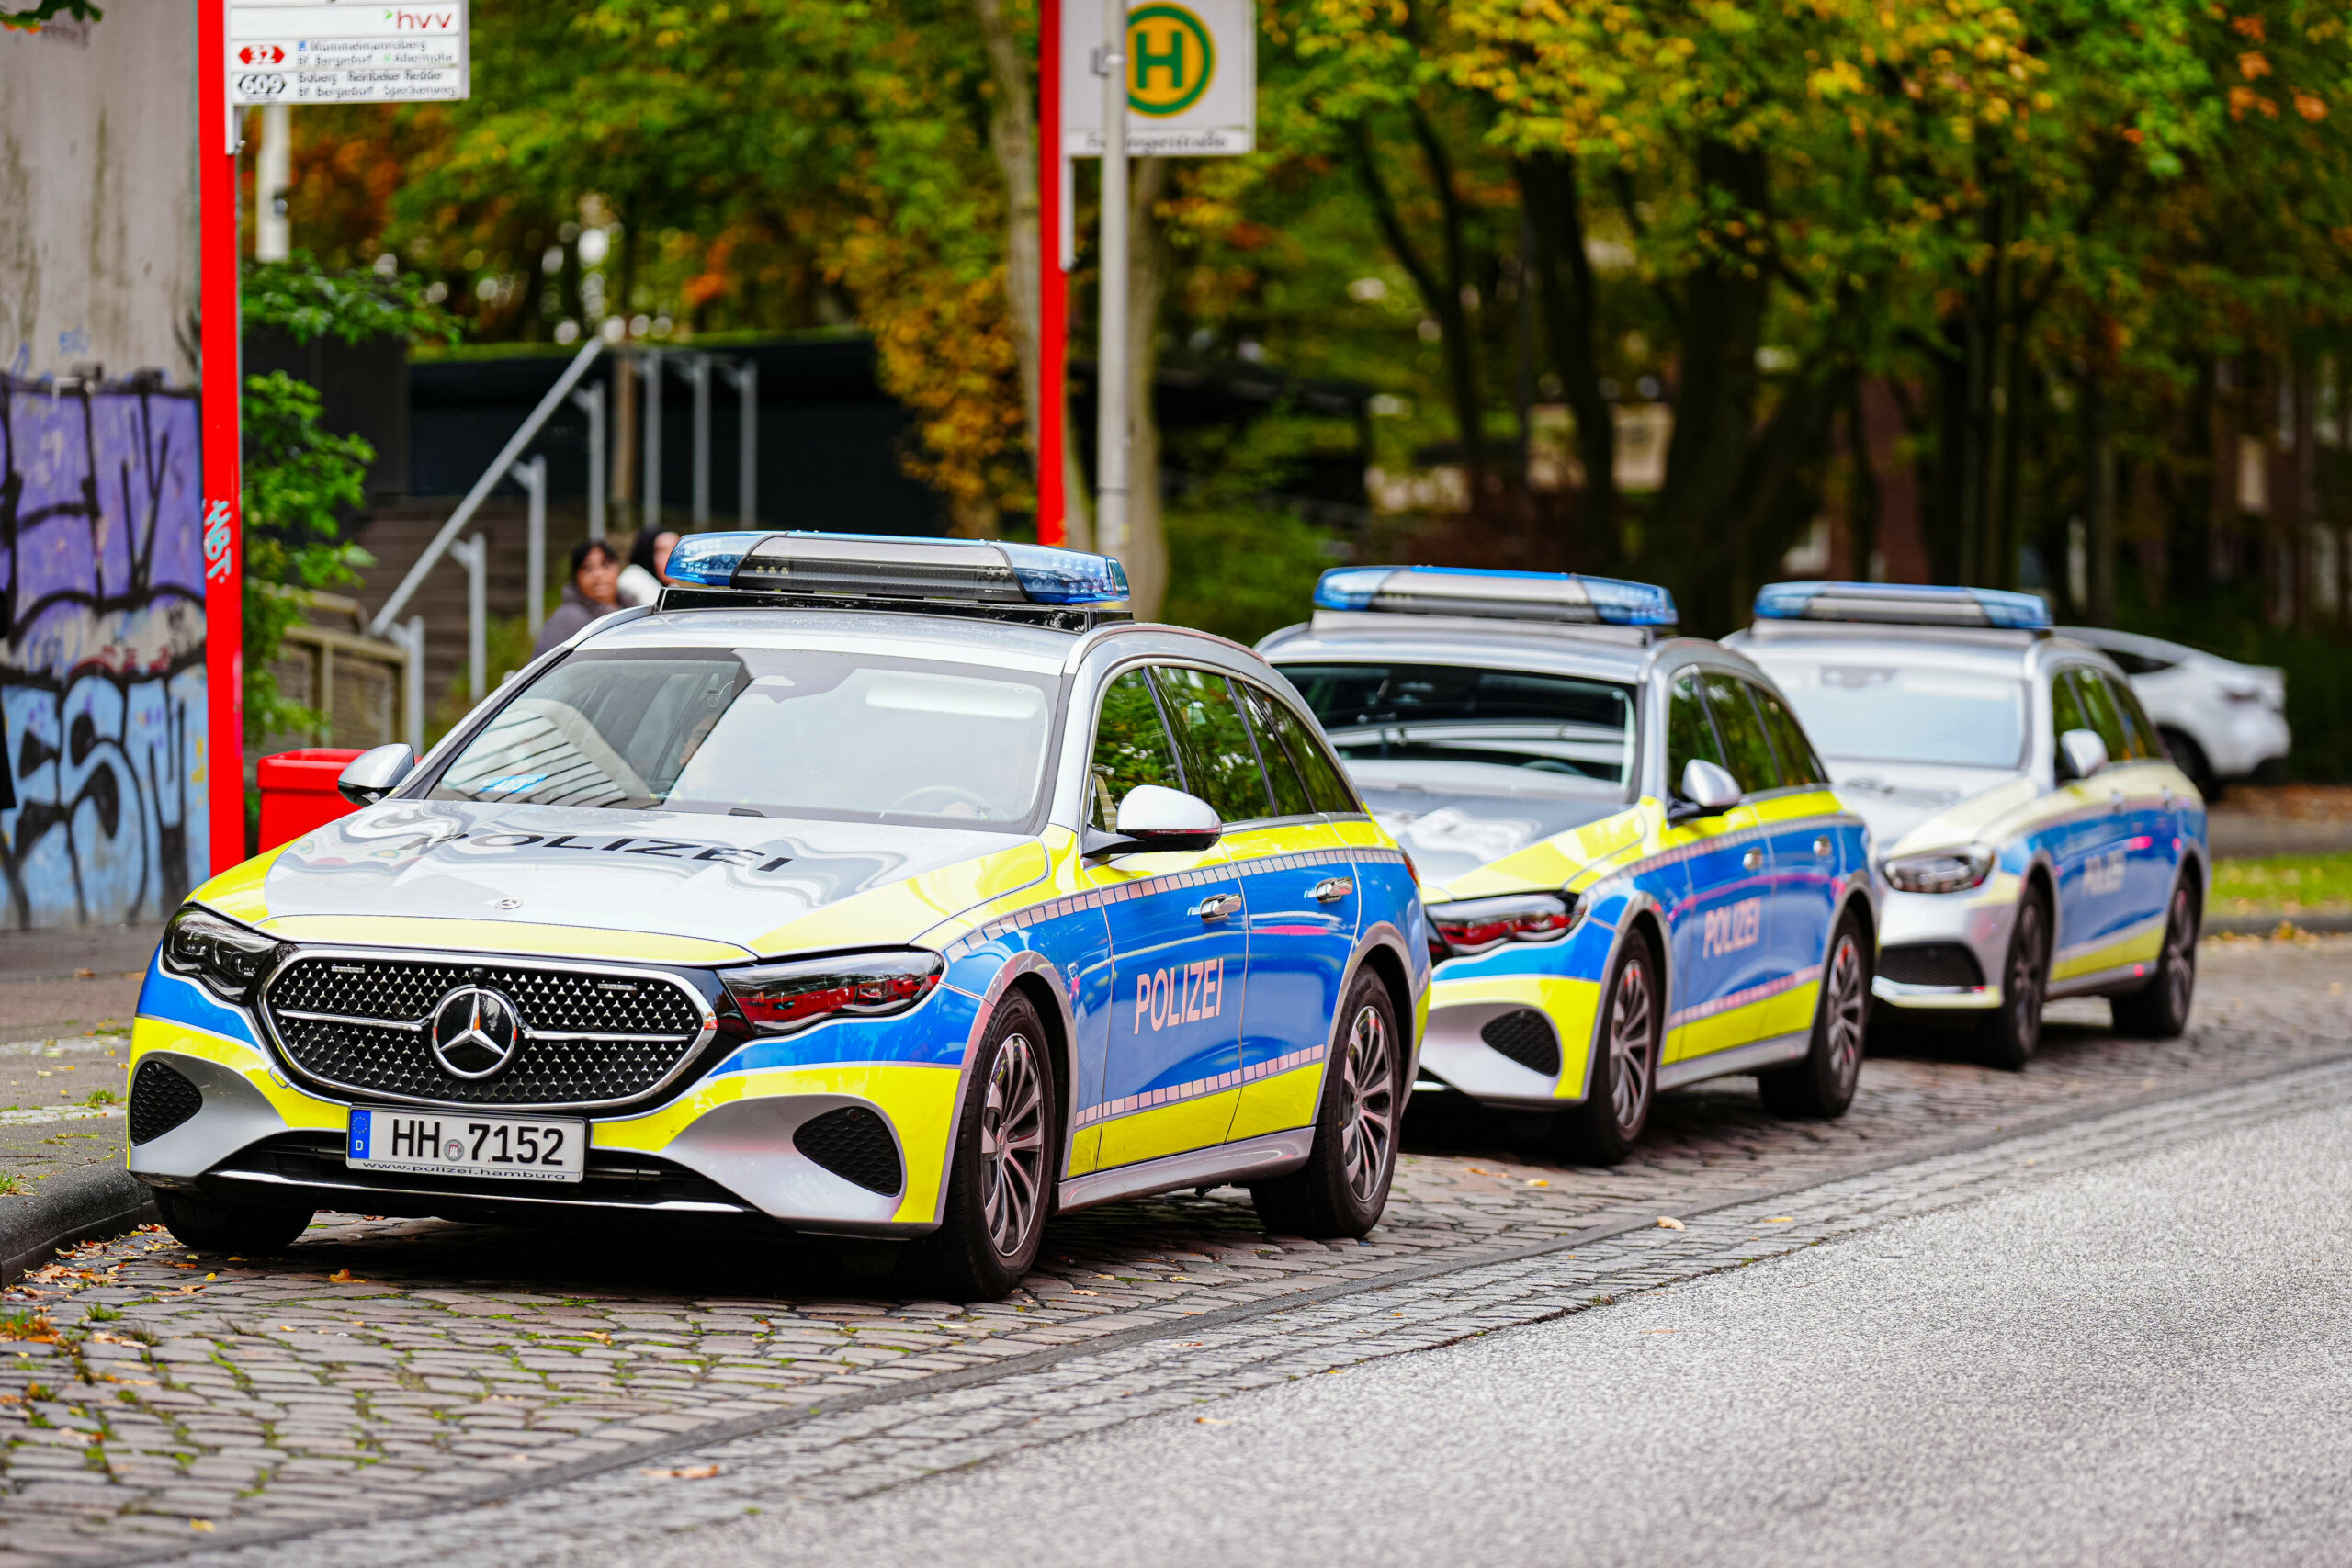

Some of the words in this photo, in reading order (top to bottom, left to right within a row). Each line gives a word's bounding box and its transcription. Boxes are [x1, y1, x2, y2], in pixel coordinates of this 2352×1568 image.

[396, 9, 453, 29] hvv
[1136, 31, 1183, 90] H
[397, 833, 794, 872] POLIZEI
[1702, 896, 1762, 960] POLIZEI
[1134, 957, 1225, 1035] POLIZEI
[355, 1140, 364, 1151] D
[391, 1118, 441, 1158] HH
[468, 1122, 564, 1167] 7152
[362, 1161, 567, 1181] www.polizei.hamburg
